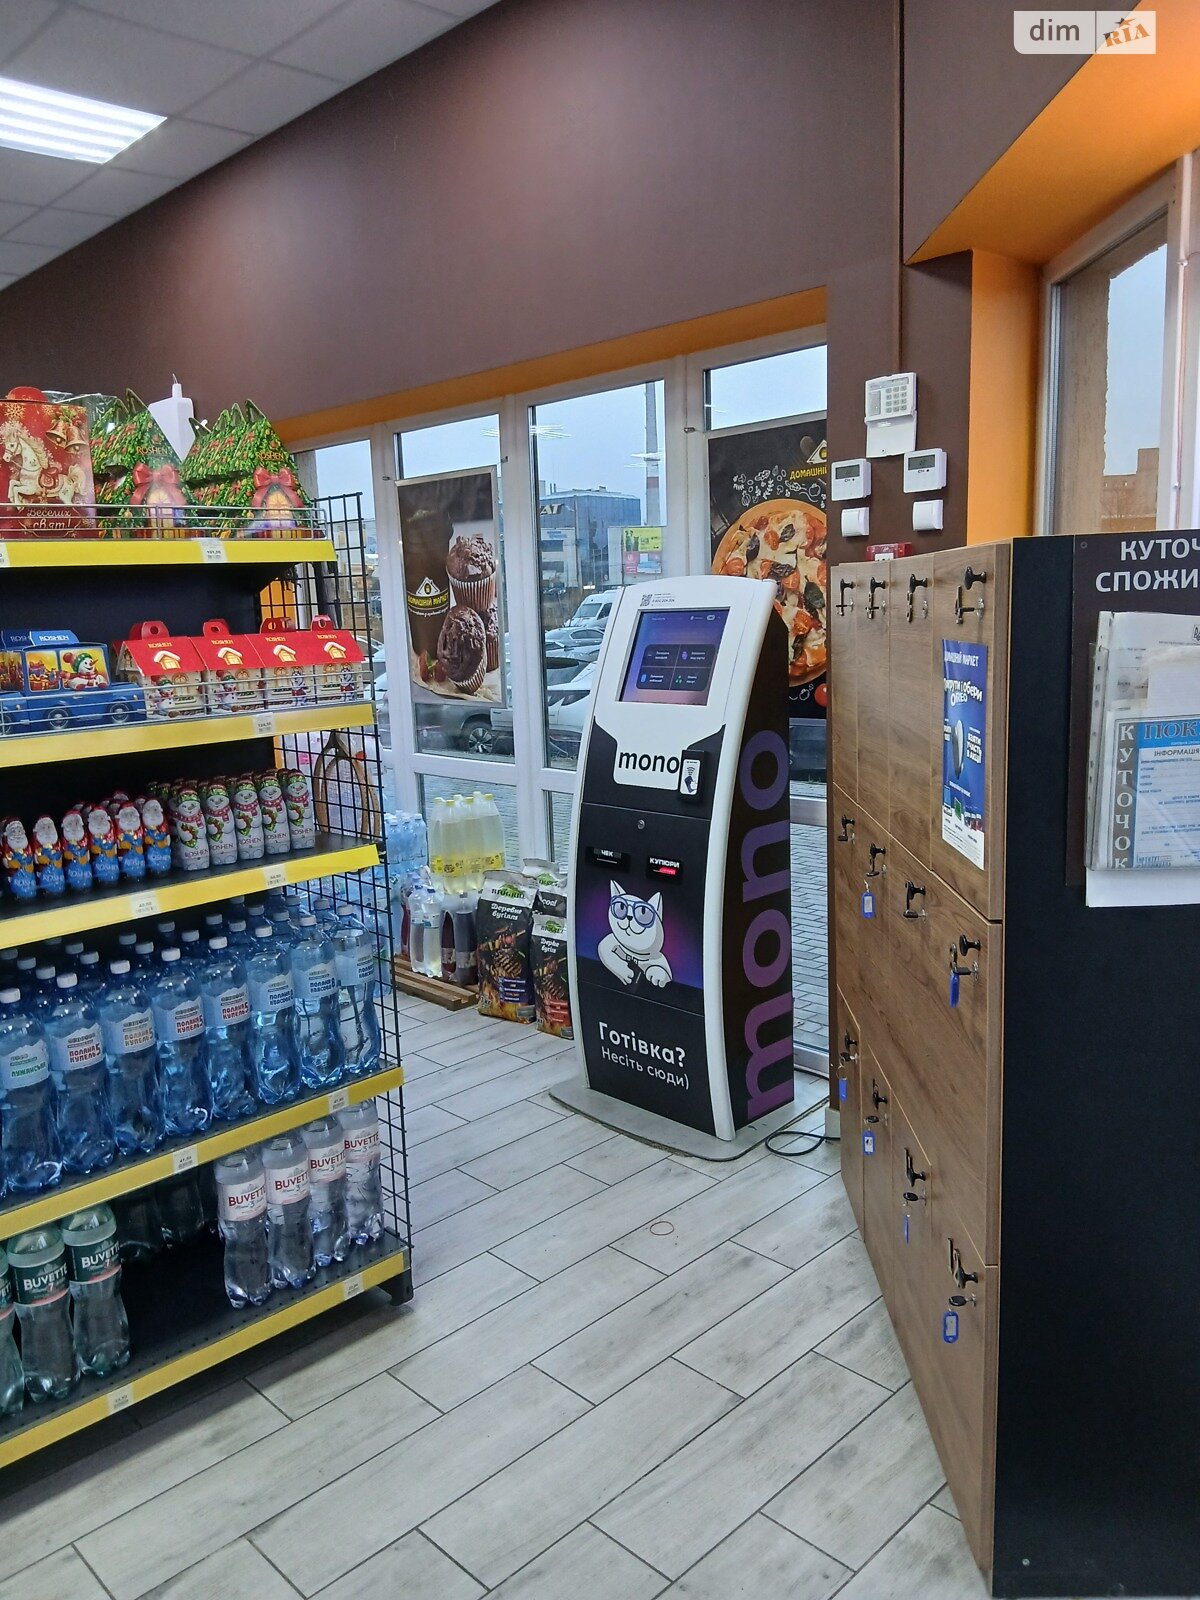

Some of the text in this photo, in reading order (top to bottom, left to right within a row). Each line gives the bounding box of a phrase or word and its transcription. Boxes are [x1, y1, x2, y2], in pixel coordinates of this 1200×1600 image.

[136, 446, 168, 455] ROSHEN
[256, 451, 284, 460] ROSHEN
[1095, 568, 1199, 592] СПОЖИ
[38, 634, 69, 642] ROSHEN
[148, 641, 173, 649] ROSHEN
[1144, 721, 1200, 740] ПОК
[1154, 748, 1200, 757] ІНФОРМАЦІЯ
[618, 752, 680, 774] mono
[1113, 725, 1134, 868] КУТОЧОК
[184, 848, 208, 857] ROSHEN
[600, 849, 614, 857] ЧЕК
[649, 857, 680, 868] КУПЮРИ
[739, 729, 795, 1120] mono
[309, 979, 331, 988] ПОЛЯНА
[244, 1002, 249, 1013] 5
[148, 1027, 154, 1040] 5
[599, 1021, 686, 1068] Готівка?
[69, 1046, 97, 1057] ПОЛЯНА
[69, 1043, 101, 1063] КУПЕЛЬ 5
[601, 1045, 689, 1090] Несіть сюди)
[343, 1131, 380, 1150] BUVETTE
[23, 1262, 68, 1291] BUVETTE
